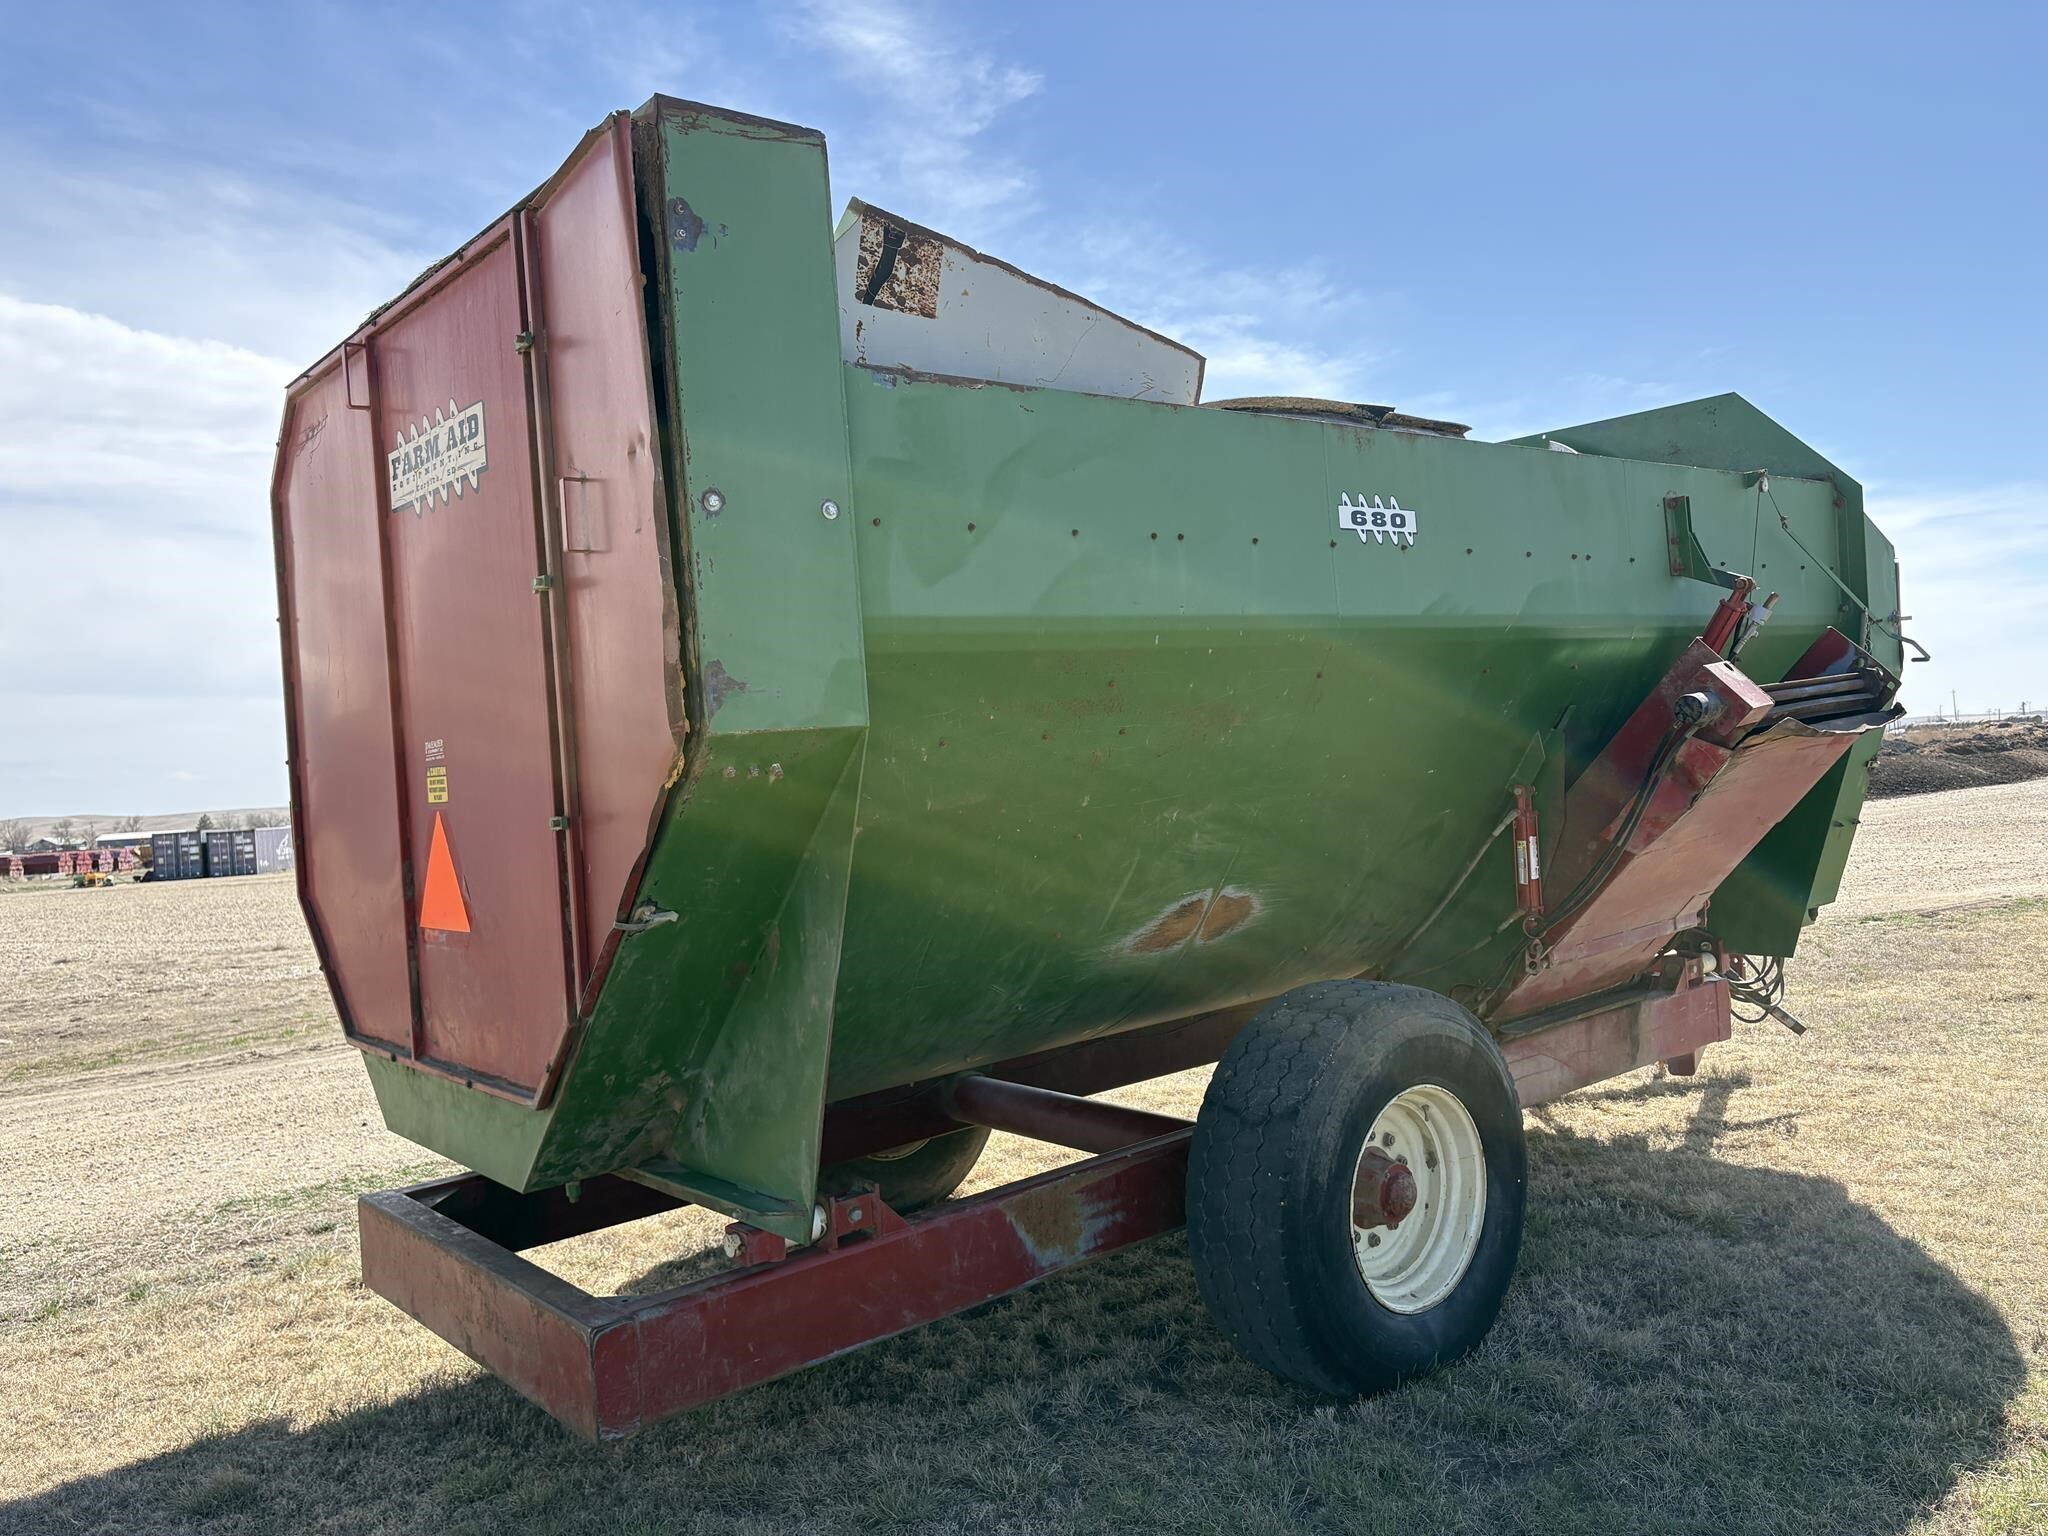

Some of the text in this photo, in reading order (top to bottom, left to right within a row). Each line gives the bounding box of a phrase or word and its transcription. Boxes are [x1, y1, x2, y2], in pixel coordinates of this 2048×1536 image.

[391, 413, 479, 481] FARM AID
[1351, 510, 1406, 529] 680
